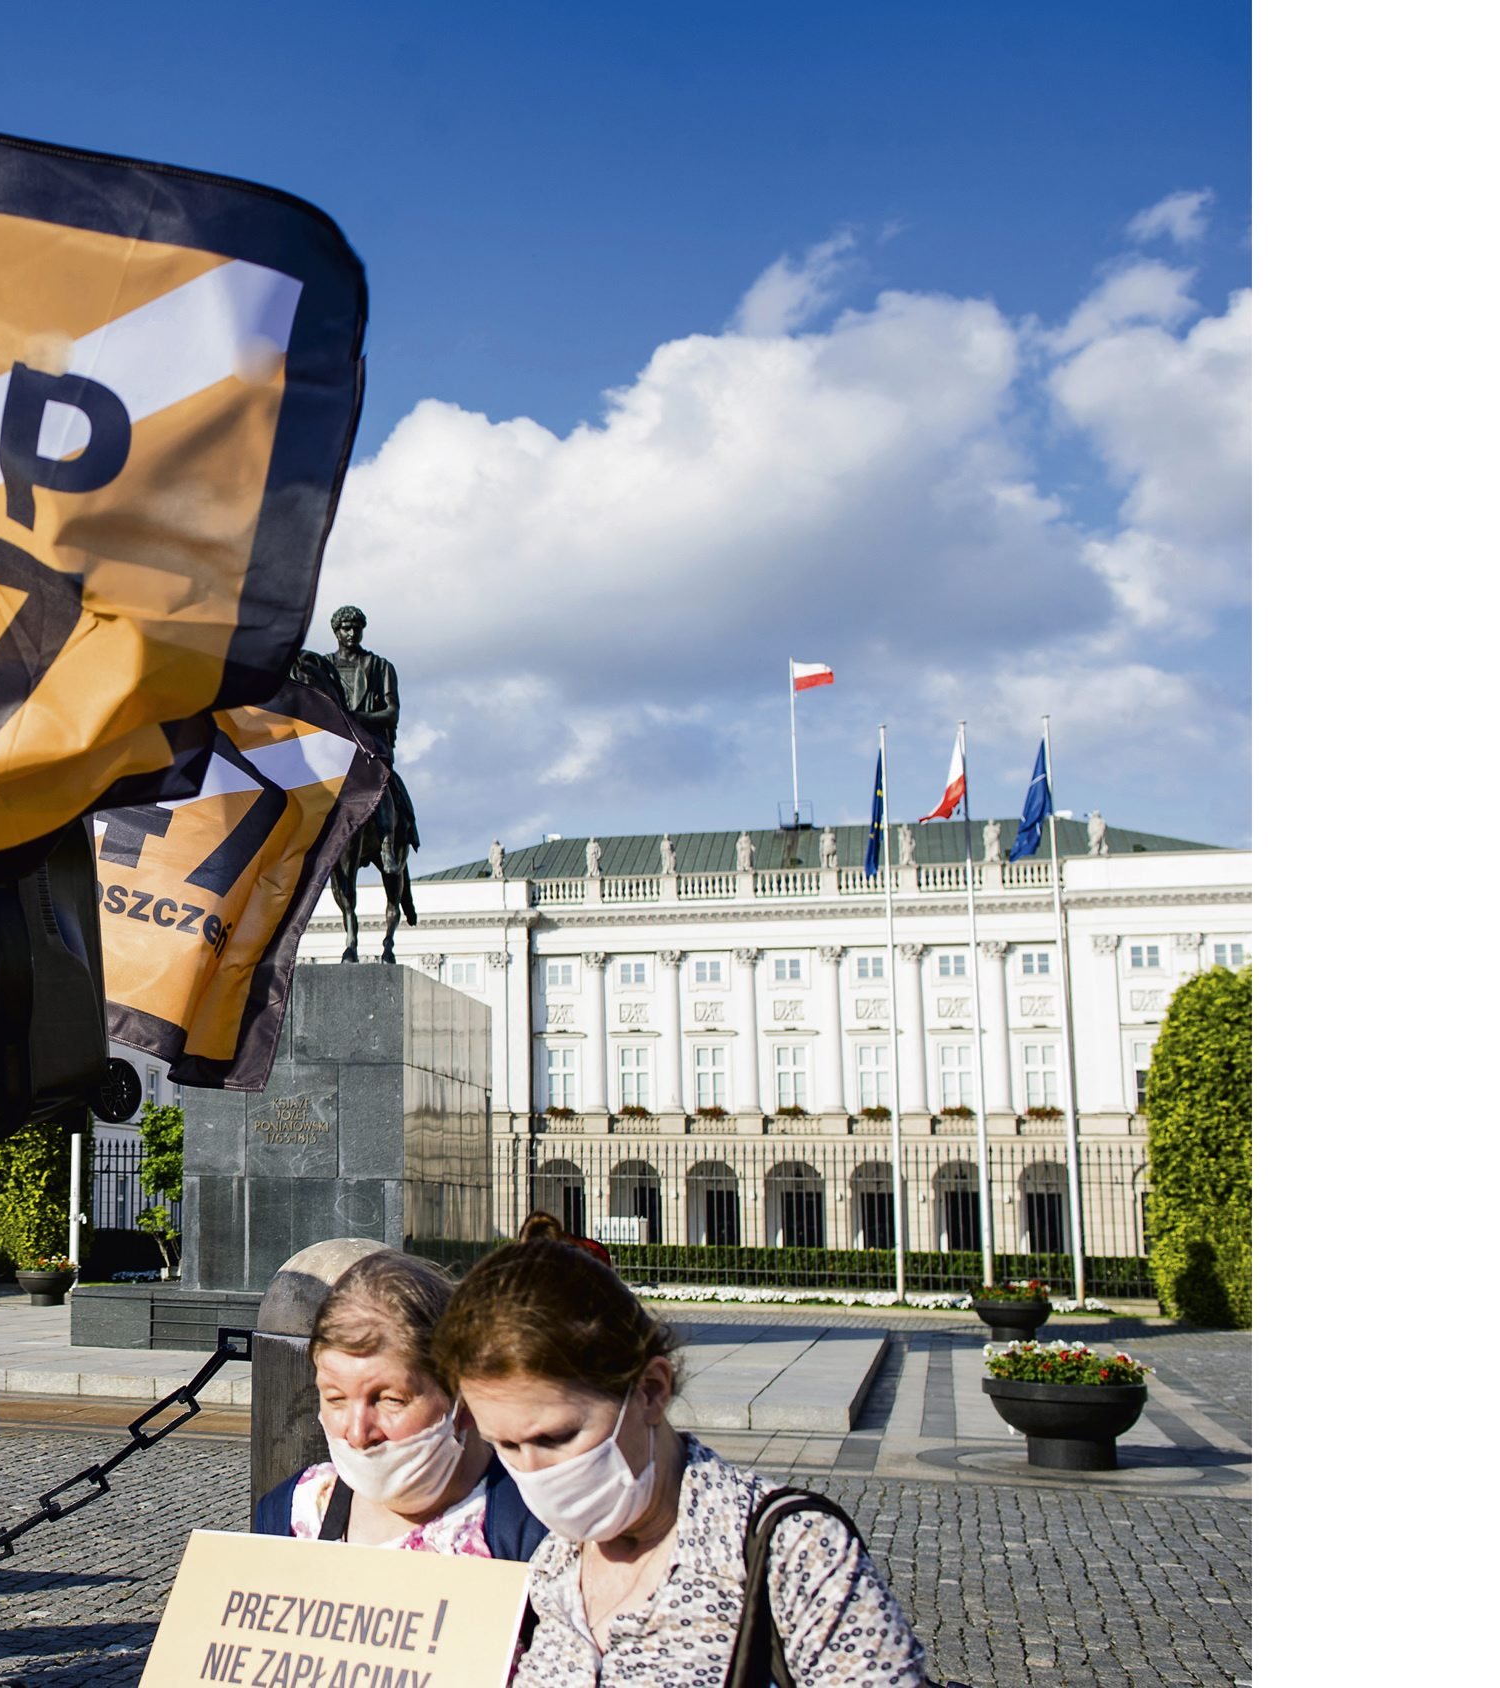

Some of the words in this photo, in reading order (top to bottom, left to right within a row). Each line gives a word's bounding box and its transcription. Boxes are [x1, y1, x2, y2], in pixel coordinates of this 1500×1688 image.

[254, 1120, 330, 1132] PONIATOWSKI
[221, 1590, 425, 1652] PREZYDENCIE
[200, 1642, 252, 1685] NIE
